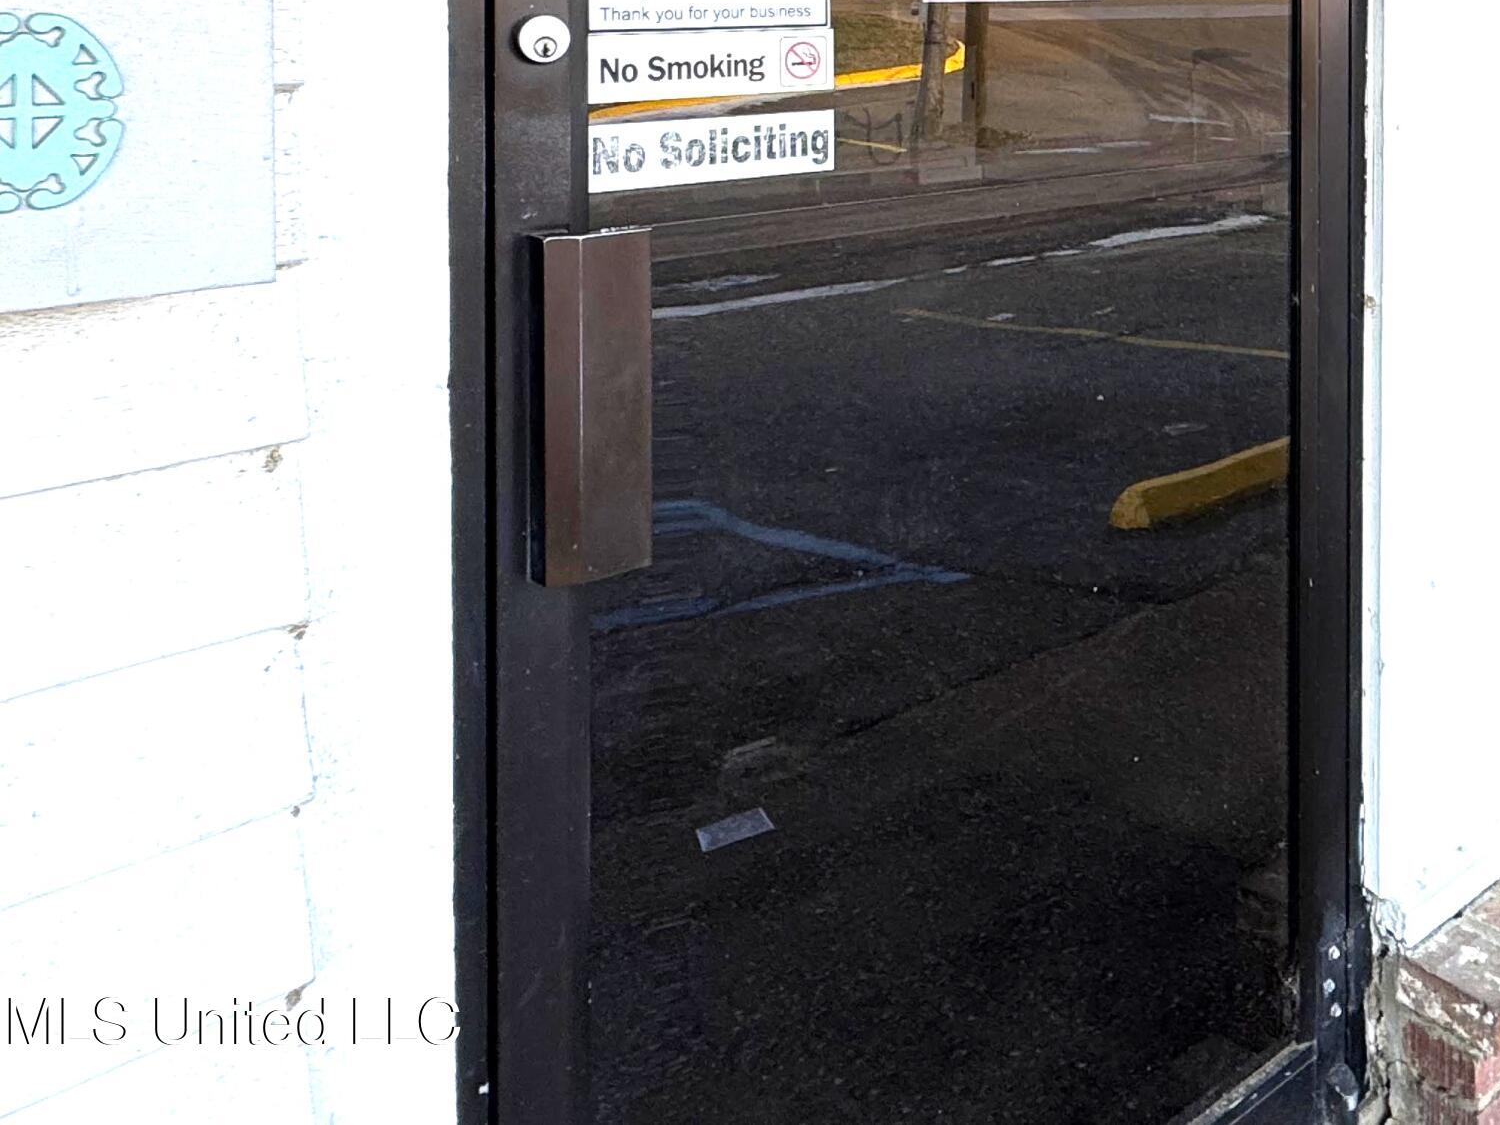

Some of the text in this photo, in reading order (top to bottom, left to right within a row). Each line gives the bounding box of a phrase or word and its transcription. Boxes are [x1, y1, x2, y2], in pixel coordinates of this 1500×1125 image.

[600, 6, 811, 24] Thank you for your business
[599, 53, 765, 83] No Smoking
[592, 123, 829, 175] No Soliciting
